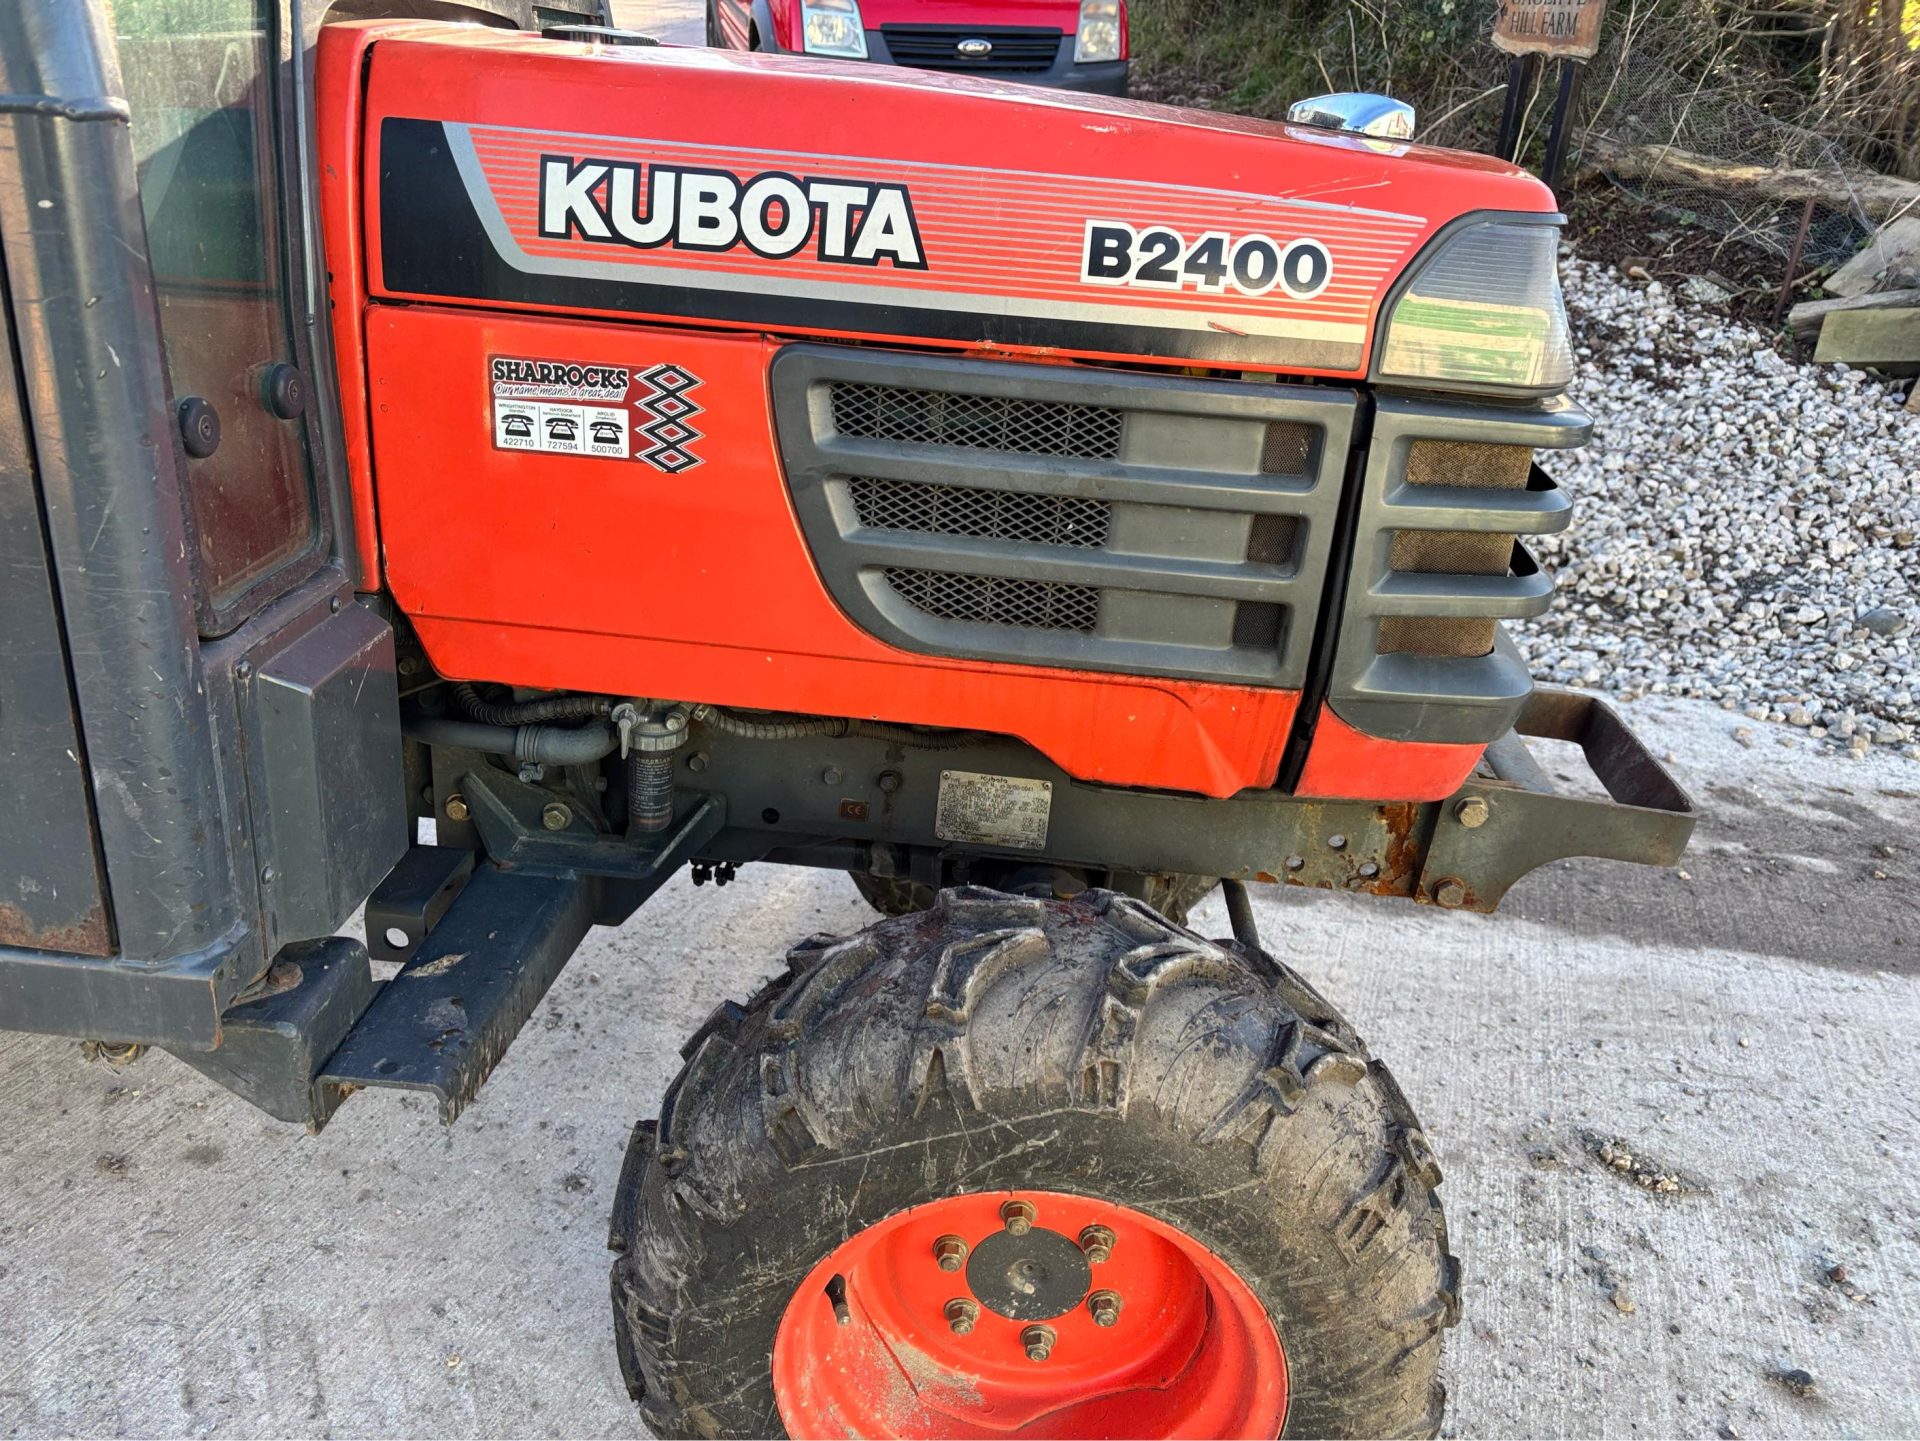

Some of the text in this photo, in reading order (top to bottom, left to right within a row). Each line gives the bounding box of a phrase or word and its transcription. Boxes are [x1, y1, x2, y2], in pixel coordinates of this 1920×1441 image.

[1510, 11, 1579, 36] HILL FARM
[541, 156, 926, 267] KUBOTA
[1083, 222, 1330, 297] B2400
[493, 359, 628, 390] SHARROCKS
[495, 383, 512, 396] Our
[513, 385, 538, 396] name
[539, 386, 569, 398] means
[571, 388, 577, 397] a
[579, 388, 602, 400] great
[503, 438, 534, 448] 422710
[547, 441, 578, 451] 727594
[591, 445, 623, 455] 500700
